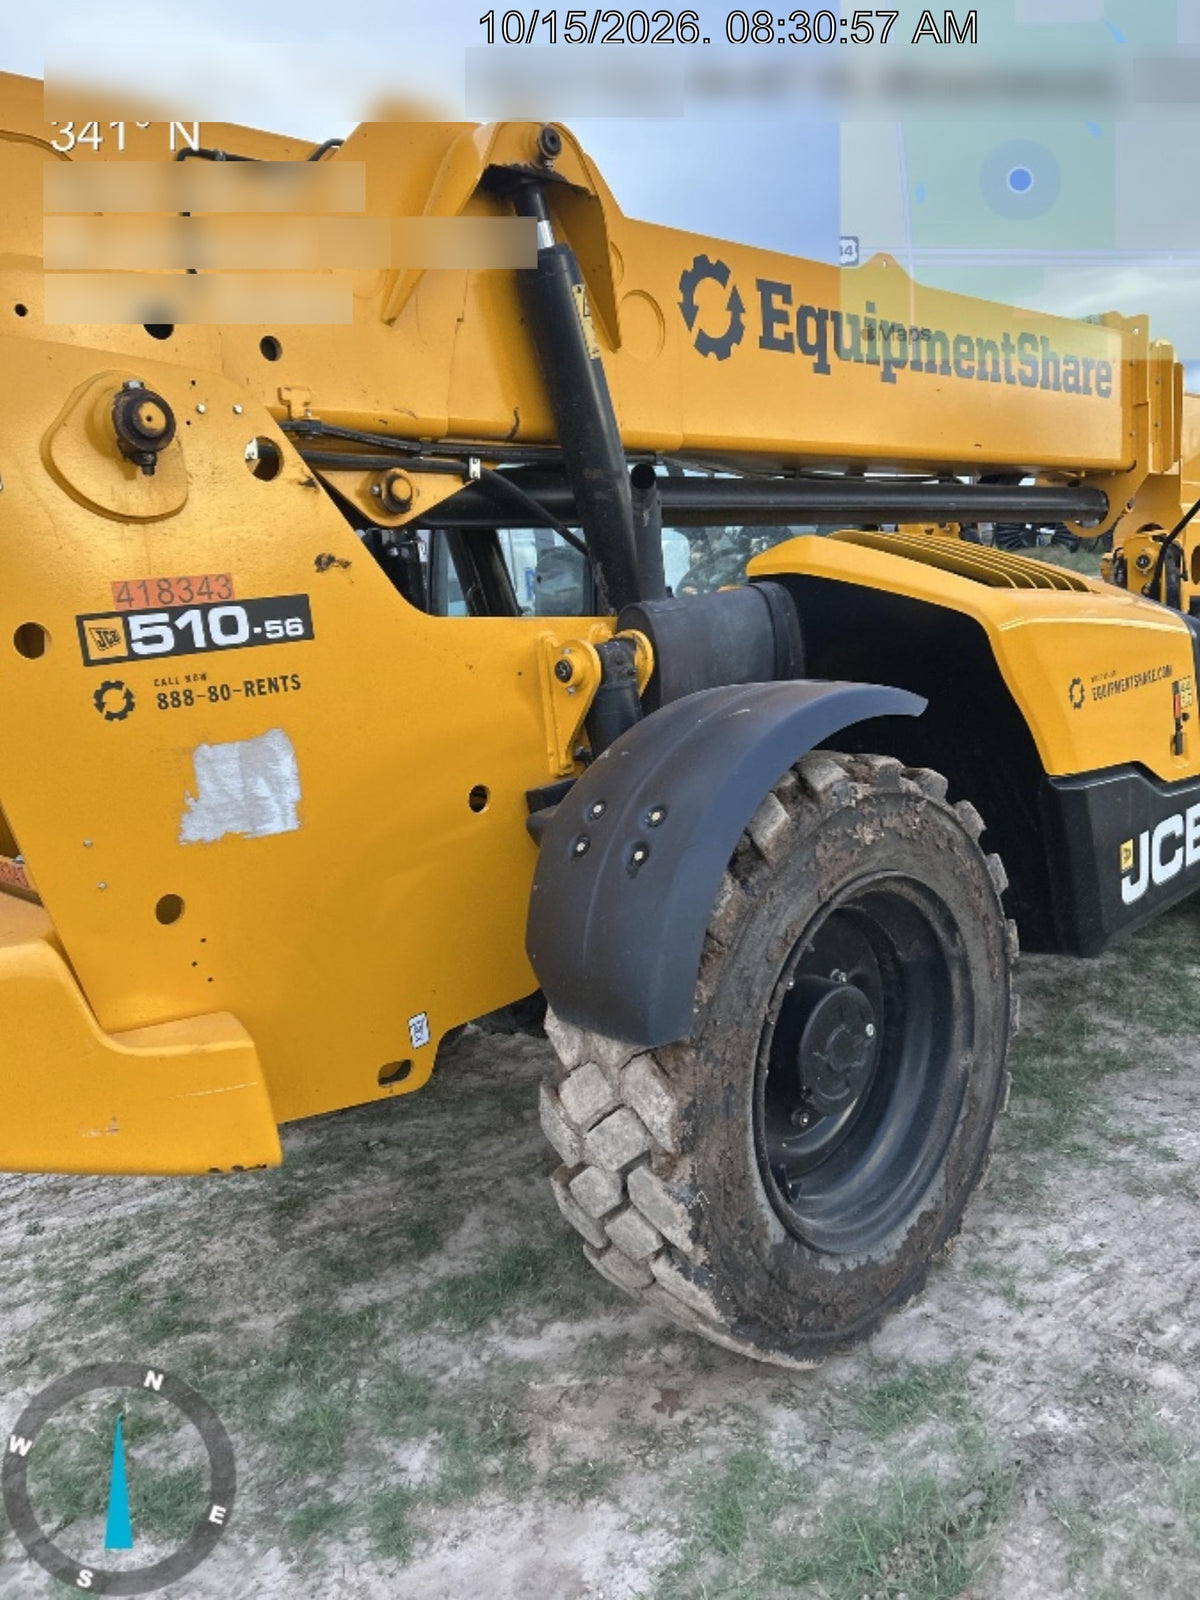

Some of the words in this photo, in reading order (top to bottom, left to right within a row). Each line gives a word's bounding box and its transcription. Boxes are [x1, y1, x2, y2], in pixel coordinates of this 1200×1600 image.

[756, 278, 1112, 399] EquipmentShare
[116, 573, 233, 608] 418343
[154, 676, 180, 687] CALL
[157, 673, 301, 710] 888-80-RENTS
